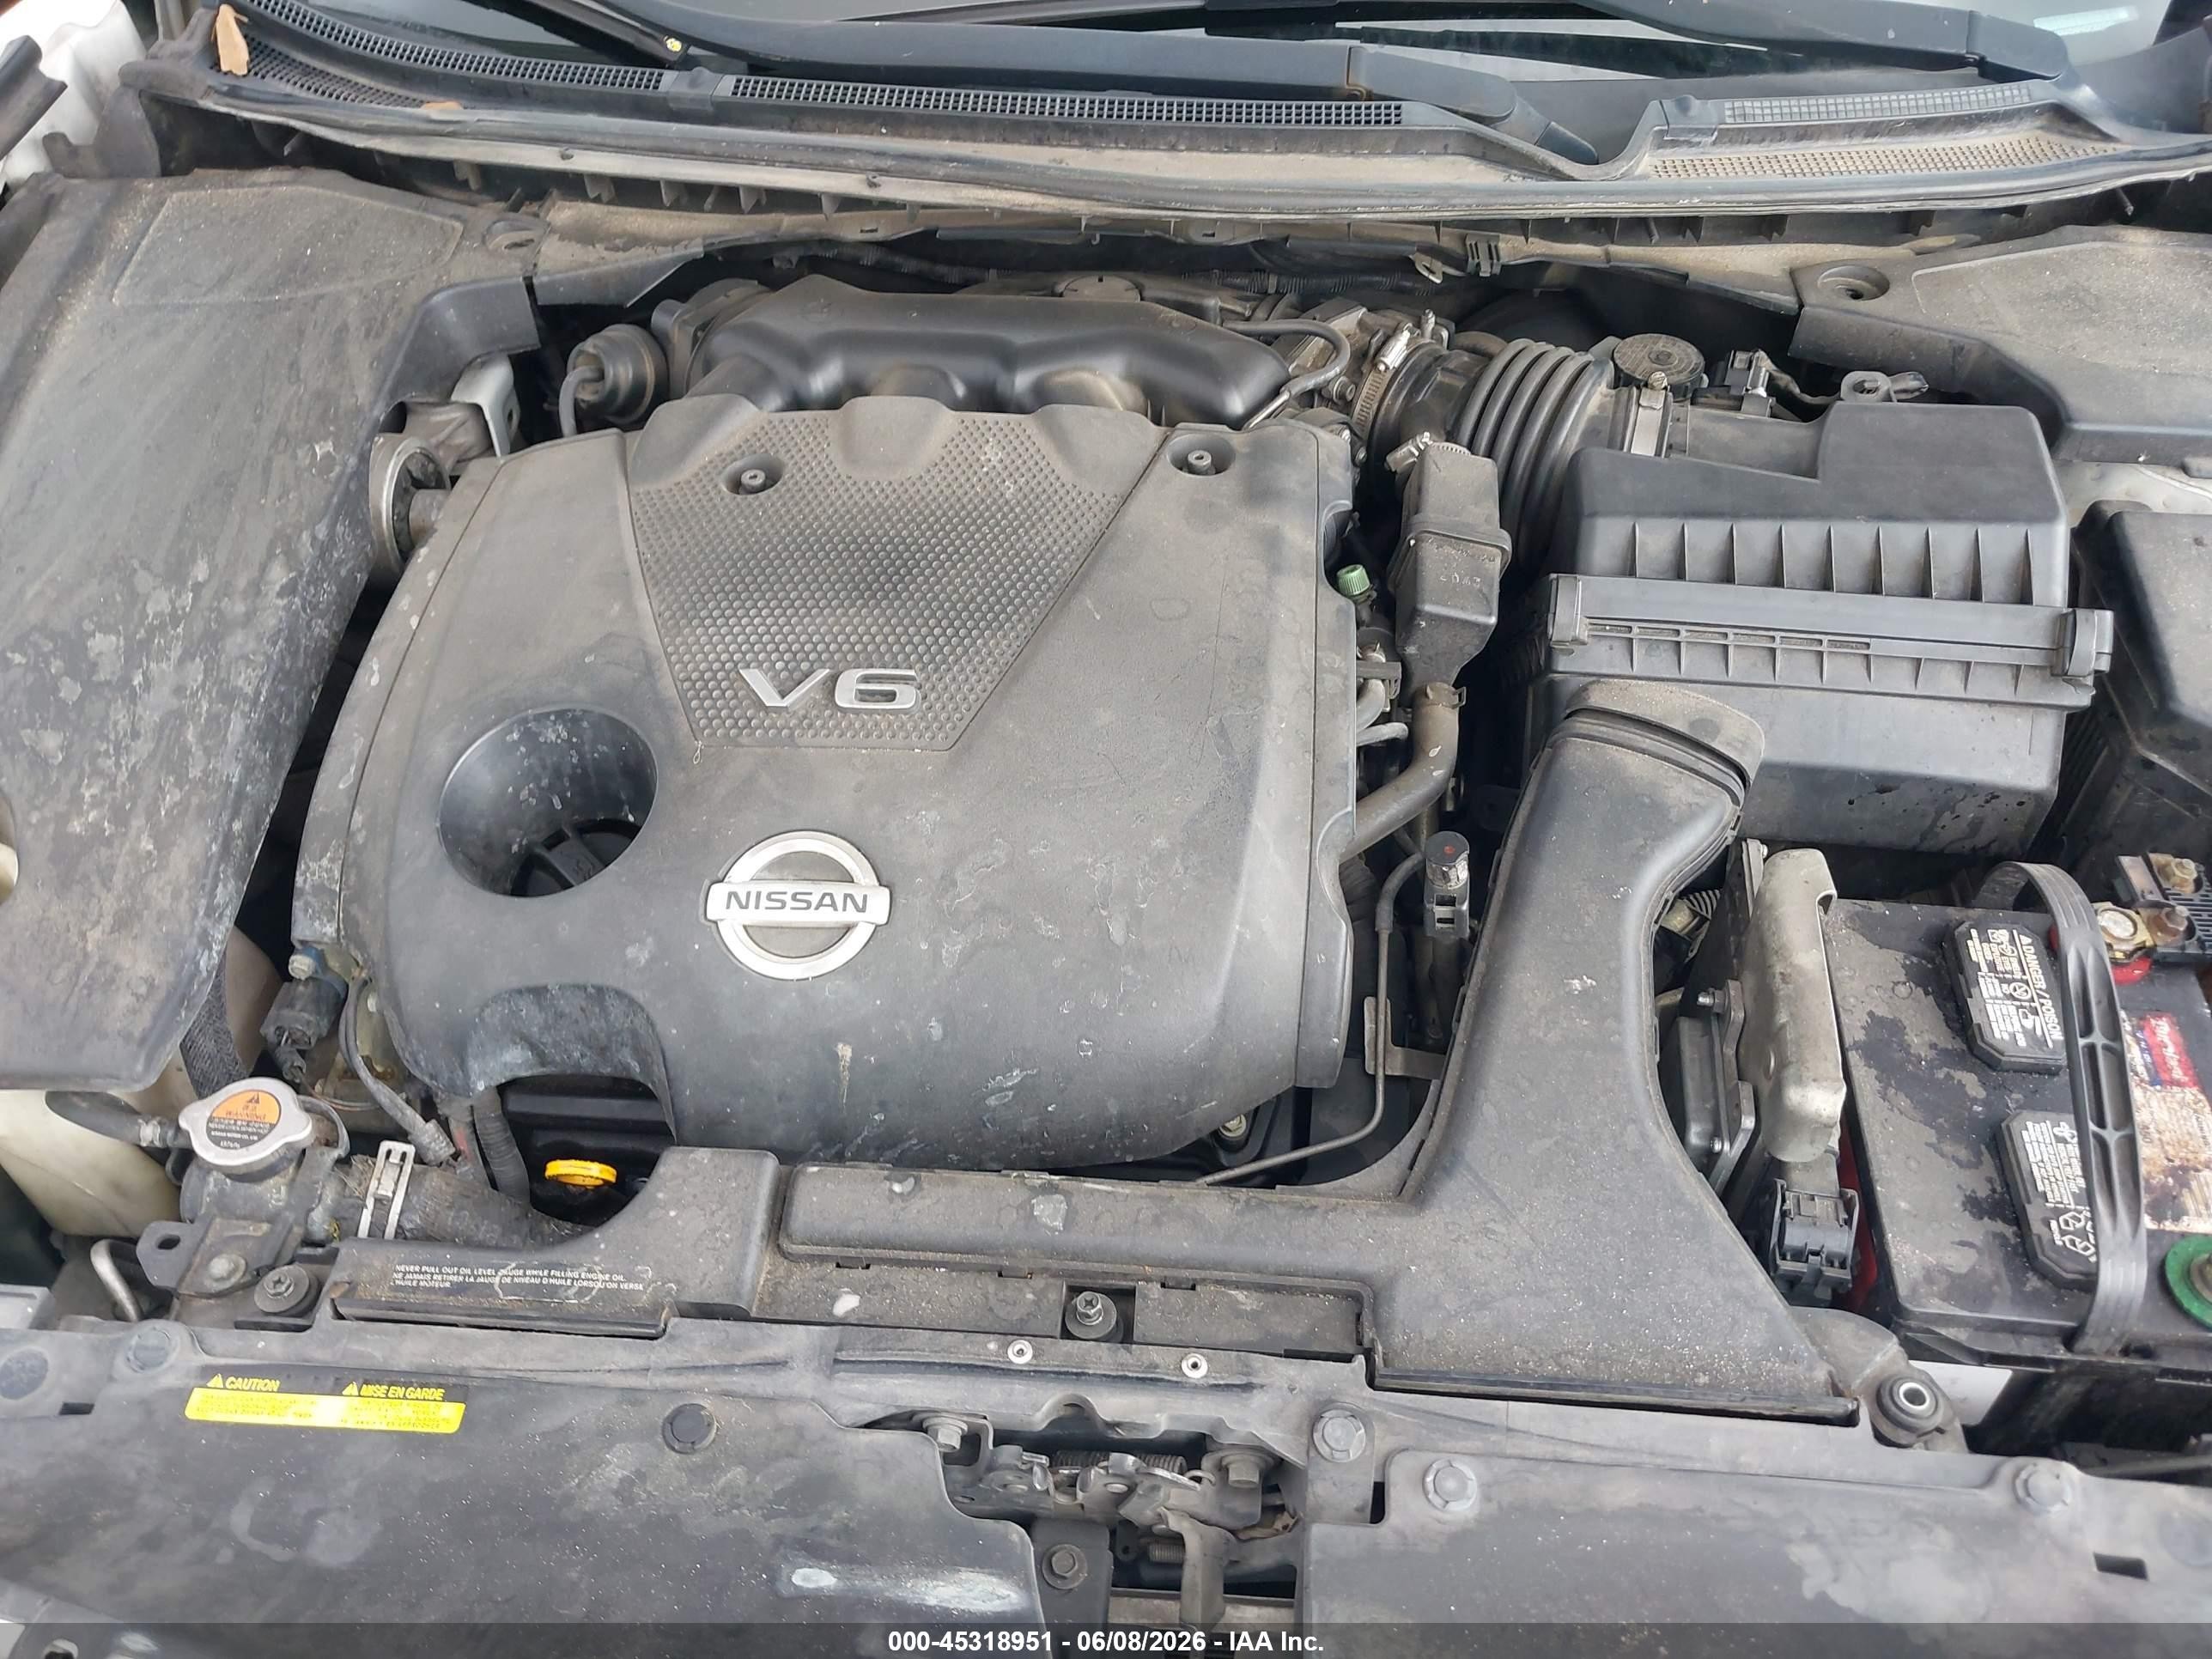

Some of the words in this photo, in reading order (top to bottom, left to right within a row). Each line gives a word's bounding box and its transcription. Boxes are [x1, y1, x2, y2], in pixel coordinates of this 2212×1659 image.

[739, 667, 921, 710] V6
[726, 890, 868, 914] NISSAN
[2021, 945, 2046, 989] DANGER
[2040, 998, 2064, 1041] POISON
[395, 1264, 421, 1273] NEVER
[421, 1265, 440, 1273] PULL
[441, 1266, 458, 1274] OUT
[459, 1267, 471, 1275] OIL
[473, 1267, 495, 1276] LEVEL
[550, 1269, 580, 1279] FILLING
[580, 1271, 611, 1280] ENGINE
[611, 1273, 627, 1282] OIL.
[514, 1276, 541, 1285] NIVEAU
[225, 1376, 281, 1392] CAUTION
[360, 1383, 388, 1398] MISE
[387, 1385, 405, 1399] EN
[404, 1387, 446, 1401] GARDE
